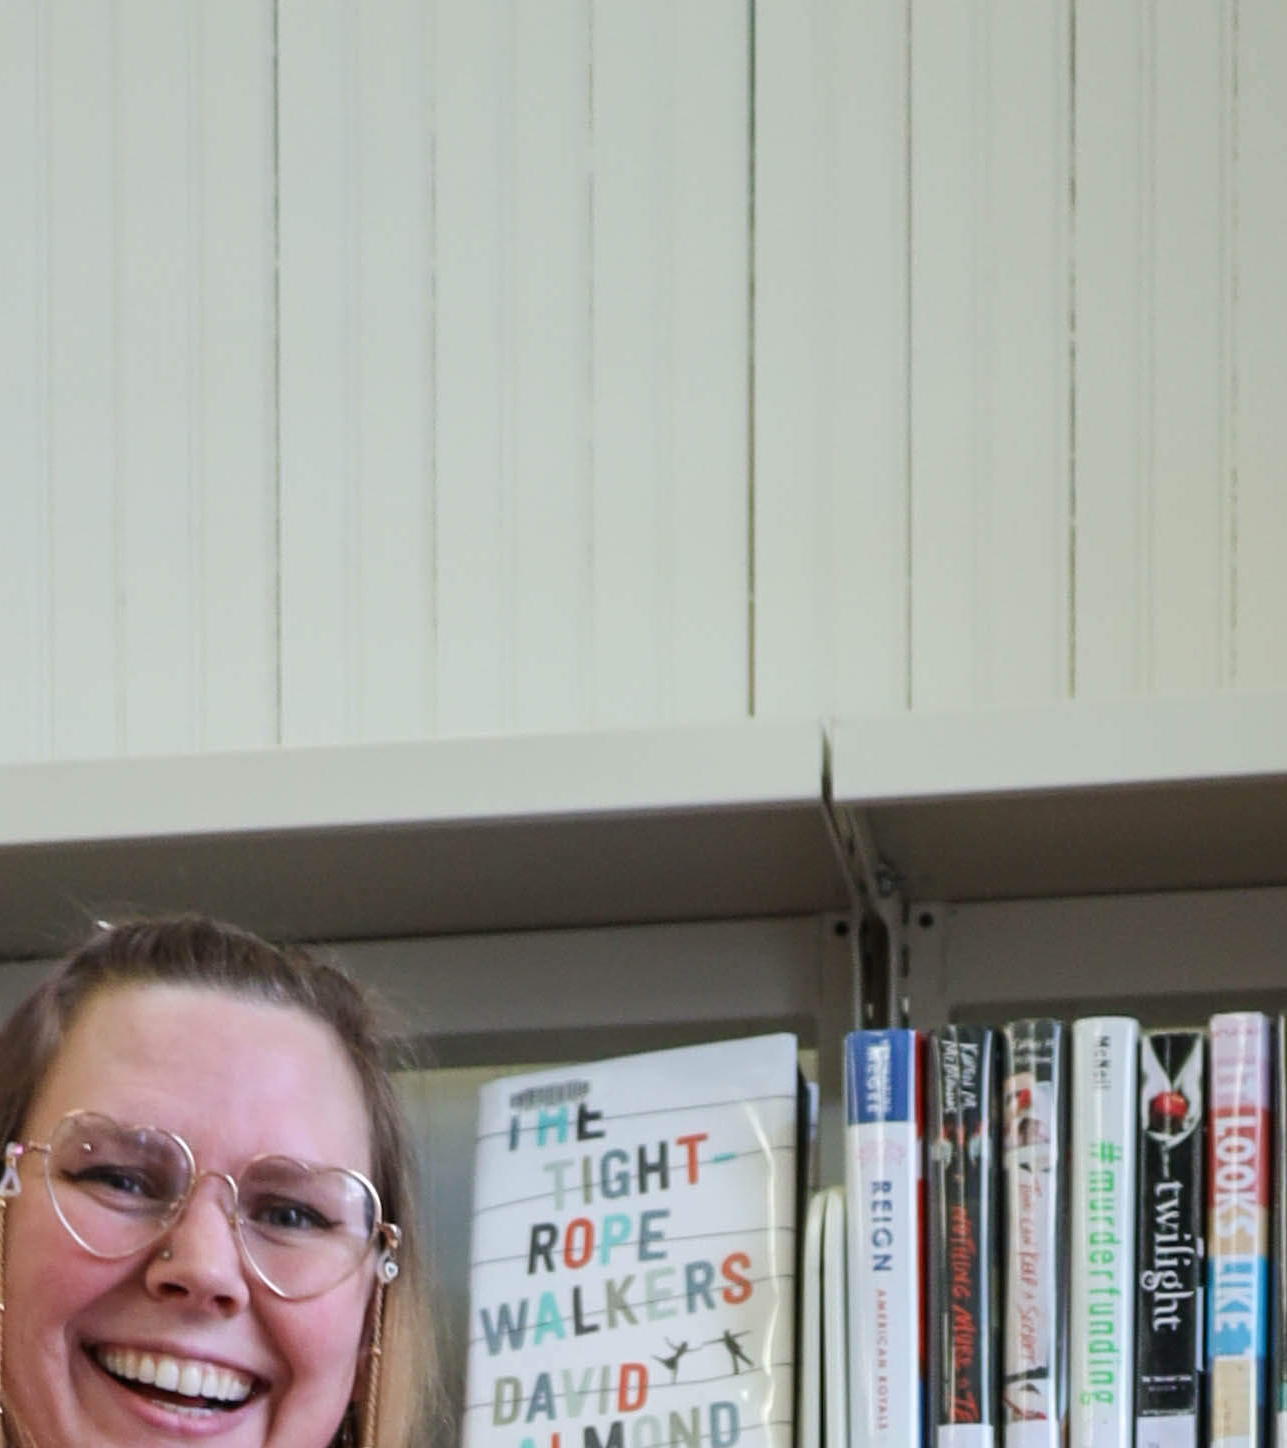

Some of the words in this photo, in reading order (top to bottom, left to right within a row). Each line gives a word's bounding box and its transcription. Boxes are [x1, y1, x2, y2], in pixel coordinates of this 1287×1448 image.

[527, 1208, 670, 1275] ROPE
[870, 1181, 893, 1272] REIGN
[1081, 1141, 1122, 1406] #murderfunding
[1141, 1181, 1198, 1331] twilight
[481, 1253, 753, 1357] WALKERS
[492, 1362, 649, 1428] DAVID
